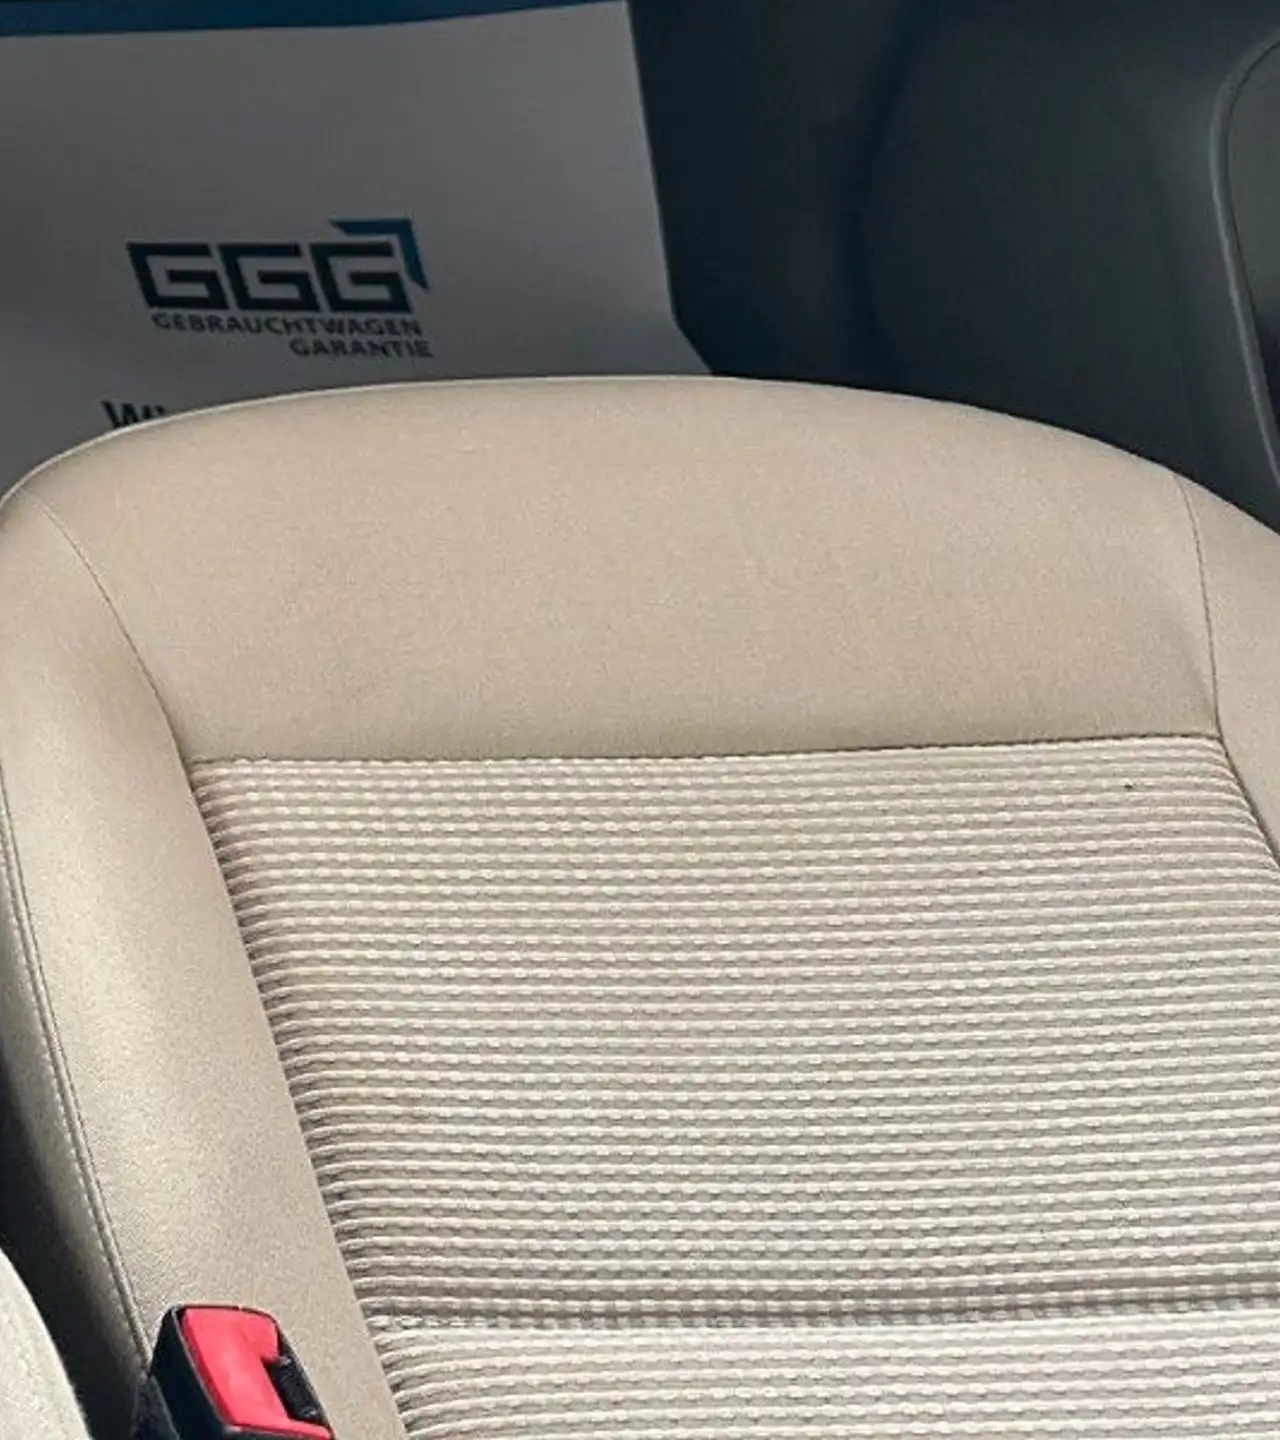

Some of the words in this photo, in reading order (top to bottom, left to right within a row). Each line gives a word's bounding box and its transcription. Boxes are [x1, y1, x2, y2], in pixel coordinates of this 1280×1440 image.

[126, 242, 413, 313] GGG
[151, 312, 422, 336] GEBRAUCHTWAGEN
[289, 337, 434, 358] GARANTIE
